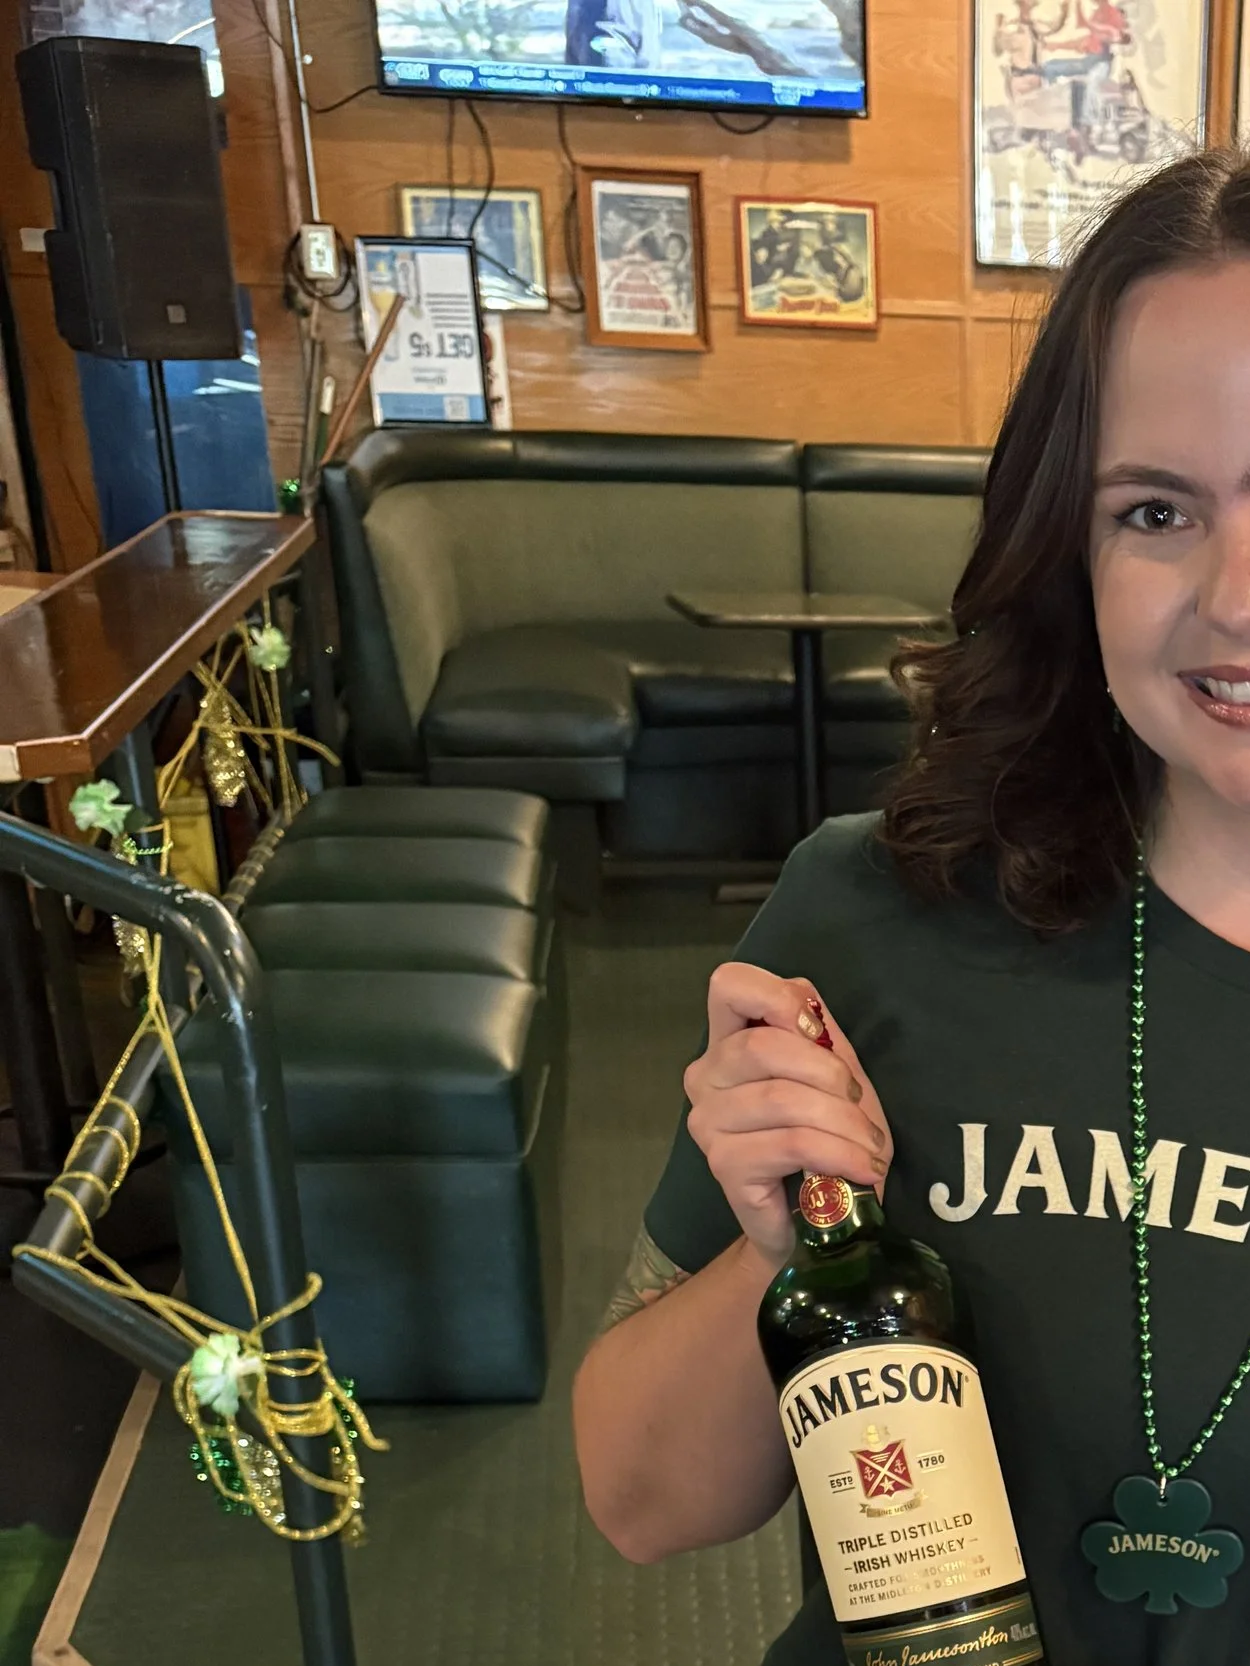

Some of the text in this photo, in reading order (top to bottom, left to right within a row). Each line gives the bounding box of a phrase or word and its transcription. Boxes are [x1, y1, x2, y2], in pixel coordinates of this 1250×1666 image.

[435, 332, 475, 359] GET
[917, 1454, 945, 1469] 1780
[837, 1512, 973, 1554] TRIPLE DISTILLED
[853, 1537, 965, 1574] IRISH WHISKEY
[848, 1578, 887, 1593] CRAFTED
[860, 1595, 876, 1605] THE
